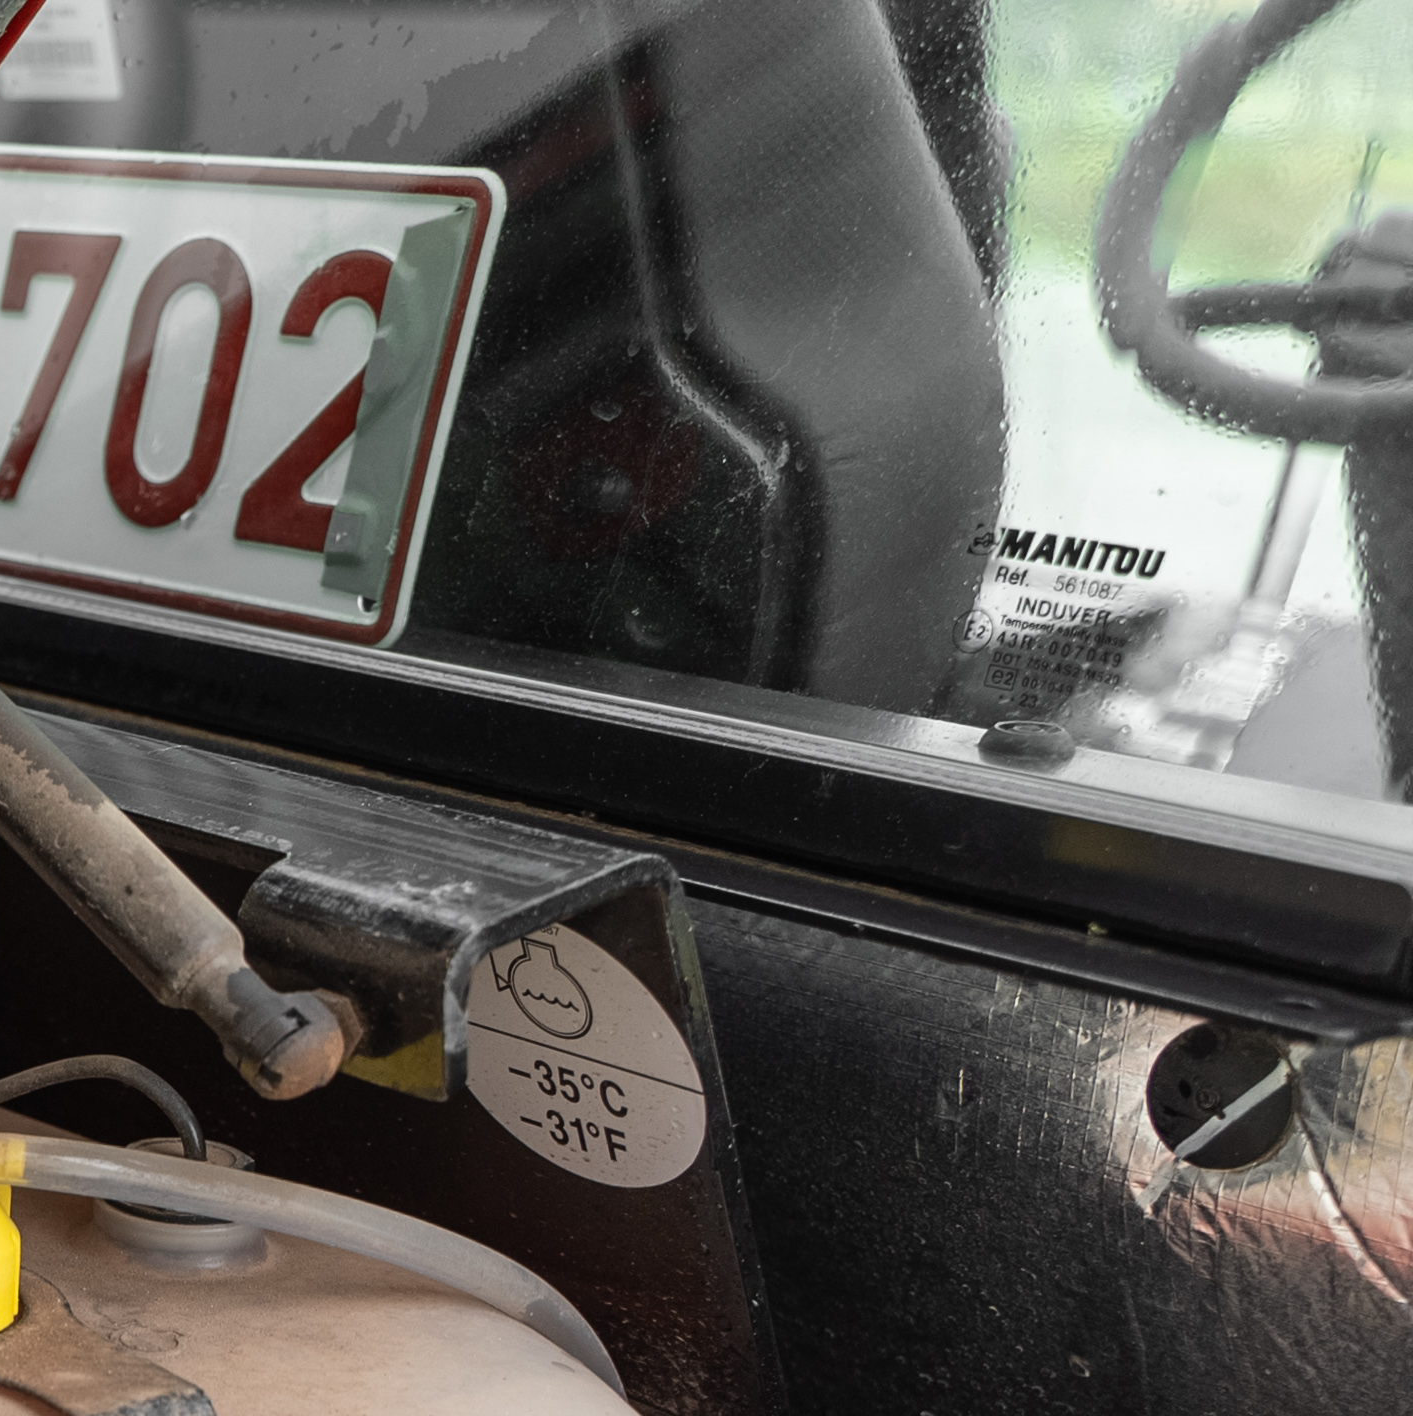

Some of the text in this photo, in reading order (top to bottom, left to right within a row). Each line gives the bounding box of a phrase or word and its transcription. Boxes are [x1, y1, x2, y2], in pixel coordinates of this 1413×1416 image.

[997, 526, 1166, 580] MANITOU
[995, 565, 1122, 601] Réf. 561087
[1015, 596, 1111, 627] INDUVER
[992, 651, 1022, 666] DOT
[991, 669, 1015, 686] e2
[508, 1059, 628, 1118] -35°C
[520, 1109, 628, 1162] -31°F
